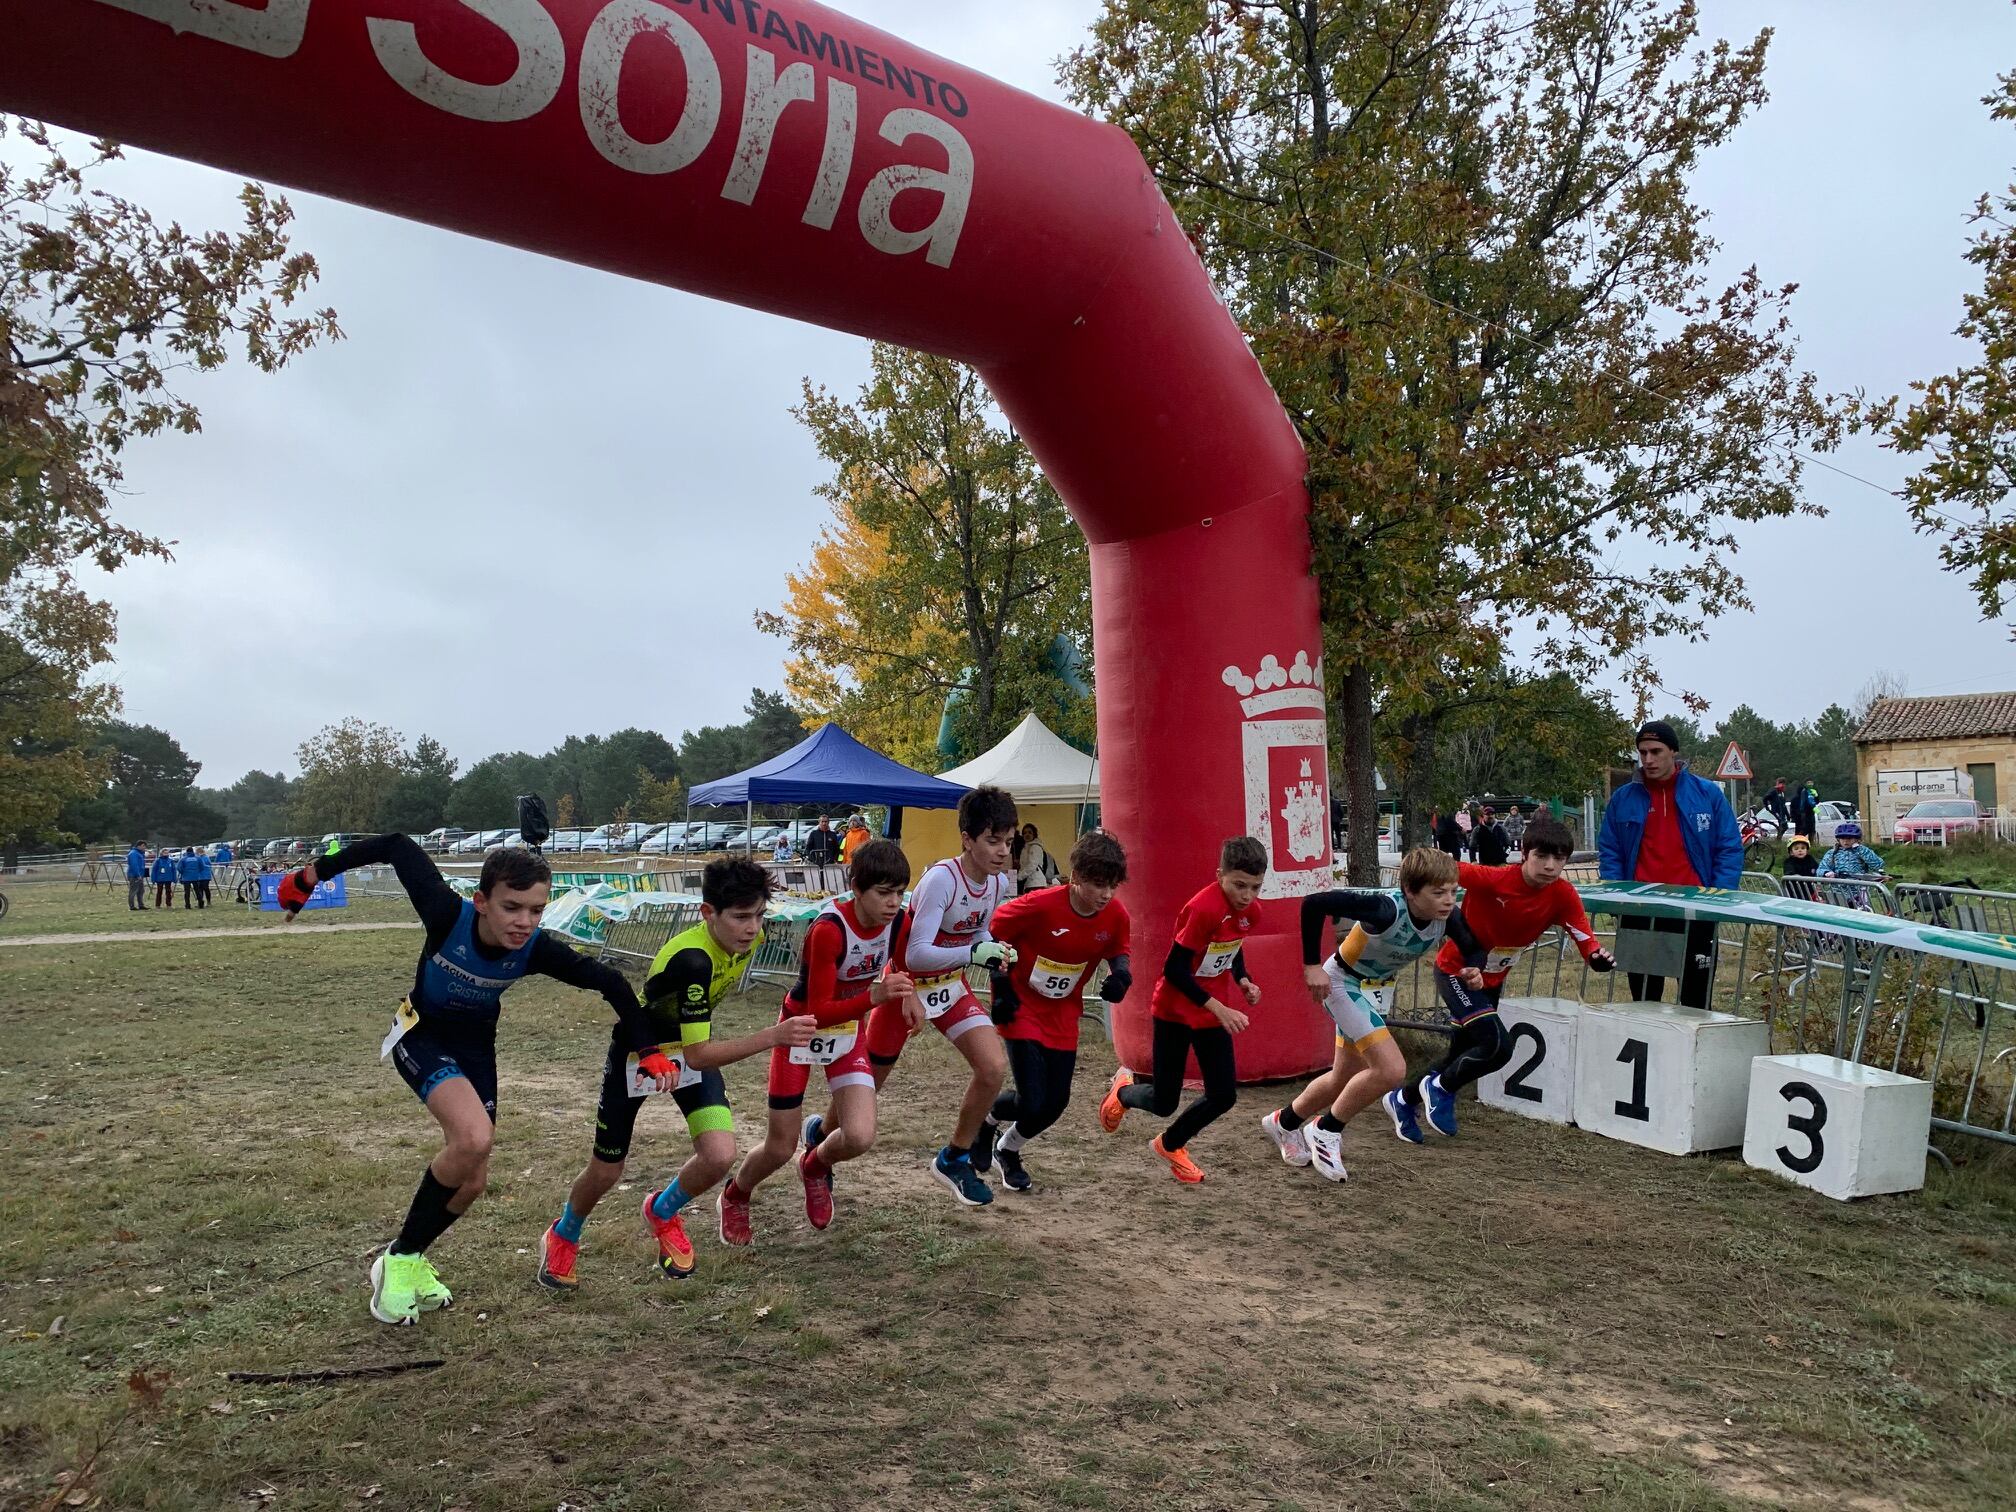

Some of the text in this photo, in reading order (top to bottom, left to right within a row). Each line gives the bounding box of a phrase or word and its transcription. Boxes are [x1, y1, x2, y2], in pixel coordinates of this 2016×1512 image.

[672, 0, 969, 118] NTAMIENTO
[438, 960, 476, 985] LAGUNA
[1213, 953, 1232, 969] 57
[926, 988, 950, 1007] 60
[1045, 976, 1070, 990] 56
[1449, 974, 1473, 1008] movistar
[809, 1037, 836, 1054] 61
[1504, 1022, 1547, 1104] 2
[1614, 1038, 1650, 1122] 1
[1775, 1081, 1828, 1174] 3
